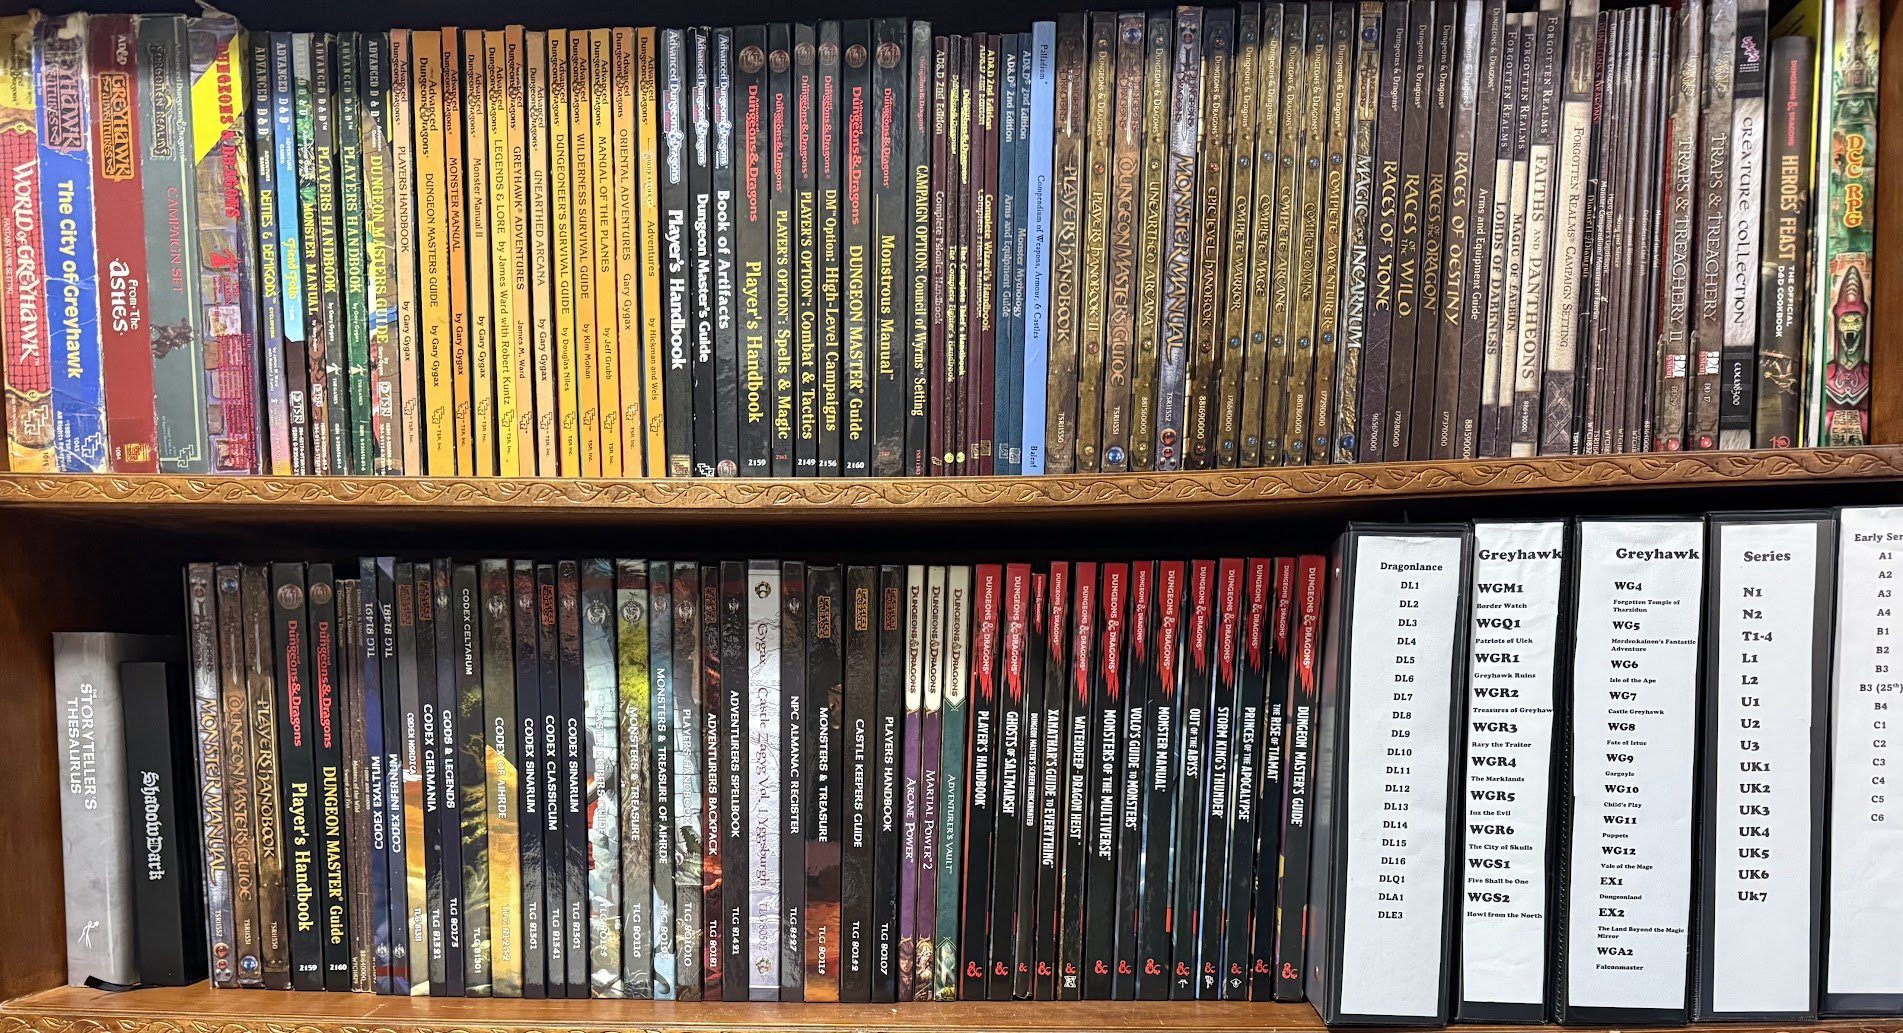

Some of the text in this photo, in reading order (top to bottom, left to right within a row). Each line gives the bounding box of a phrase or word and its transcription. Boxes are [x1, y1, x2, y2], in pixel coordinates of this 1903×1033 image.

[397, 146, 410, 253] PLAYERS HANDBOOK
[473, 157, 482, 196] Monster
[619, 128, 631, 261] ORIENTAL ADVENTURES
[1034, 174, 1046, 223] Compendium
[1845, 134, 1865, 228] DCC RPG
[317, 146, 336, 294] PLAYERS HANDBOOK
[474, 197, 483, 230] Manual
[534, 169, 546, 286] UNEARTHED ARCANA
[556, 134, 570, 315] DUNGEONEER'S SURVIVAL GUIDE
[1036, 224, 1044, 233] of
[1703, 132, 1728, 322] TRAPS & TREACHERY
[1778, 155, 1800, 261] HEROES' FEAST
[167, 187, 184, 294] CAMPAIGN SET
[425, 173, 439, 308] DUNGEON MASTERS GUIDE
[1033, 234, 1044, 269] Weapons,
[1375, 160, 1398, 311] RACES OF STONE
[1470, 188, 1488, 320] Arms and Equipment Guide
[57, 179, 83, 379] The City of Greyhawk
[717, 190, 732, 329] Book of Artifacts
[1521, 155, 1548, 380] FAITHS AND PANTHEONS
[667, 209, 687, 370] Player's Handbook
[912, 165, 929, 416] CAMPAIGN OPTION: Council of Setting
[1033, 270, 1043, 301] Armour,
[1775, 264, 1786, 337] D&D COOKBOOK
[1786, 285, 1794, 327] OFFICIAL
[401, 301, 412, 362] by Gary Gygax
[775, 210, 791, 439] PLAYER'S Spells & Magic
[849, 245, 863, 440] DUNGEON Guide
[1033, 312, 1042, 339] Castles
[582, 323, 592, 379] by Kim Mohan
[822, 266, 839, 432] High-Level Campaigns
[1478, 548, 1562, 564] Greyhawk
[1615, 548, 1703, 563] Greyhawk
[1743, 550, 1791, 562] Series
[1854, 533, 1883, 543] Early
[1879, 552, 1892, 560] A1
[1380, 562, 1443, 573] Dragonlance
[1400, 581, 1419, 590] DL1
[1477, 583, 1523, 593] WGM1
[1614, 581, 1642, 591] WG4
[1743, 587, 1762, 598] N1
[1877, 608, 1891, 617] A4
[1476, 618, 1521, 630] WGQ1
[1612, 621, 1640, 631] WG5
[1742, 631, 1773, 642] T1-4
[1876, 646, 1890, 654] B2
[1741, 675, 1759, 685] L2
[1005, 711, 1019, 758] GHOSTS OF
[1392, 711, 1412, 720] DL8
[67, 696, 82, 794] THESAURUS
[80, 683, 98, 810] STORYTELLER'S
[423, 704, 437, 812] CODEX GERMANIA
[442, 709, 455, 809] GODS & LEGENDS
[656, 668, 668, 865] MONSTERS & TREASURE OF AIHRDE
[730, 690, 740, 838] ADVENTURERS SPELLBOOK
[790, 696, 800, 834] NPC ALMANAC REGISTER
[1045, 709, 1059, 807] XANATHAR'S GUIDE TO
[1292, 706, 1310, 795] DUNGEON MASTER'S
[1387, 748, 1412, 756] DL10
[1740, 740, 1760, 751] U3
[1740, 761, 1771, 772] UK1
[1872, 758, 1886, 766] C3
[545, 715, 558, 831] CODEX CLASSICUM
[883, 716, 894, 832] PLAYERS HANDBOOK
[1070, 716, 1086, 839] WATERDEEP DRAGON HEIST
[140, 770, 165, 881] ShadowDark
[1469, 824, 1515, 835] WGR6
[1870, 813, 1884, 822] C6
[291, 782, 314, 932] Player's Handbook
[1381, 857, 1406, 865] DL16
[1601, 846, 1636, 856] WG12
[1379, 874, 1405, 885] DLQ1
[1467, 892, 1510, 903] WGS2
[1600, 877, 1623, 886] EX1
[1737, 891, 1768, 902] Uk7
[1378, 911, 1403, 919] DLE3
[1597, 947, 1634, 956] WGA2
